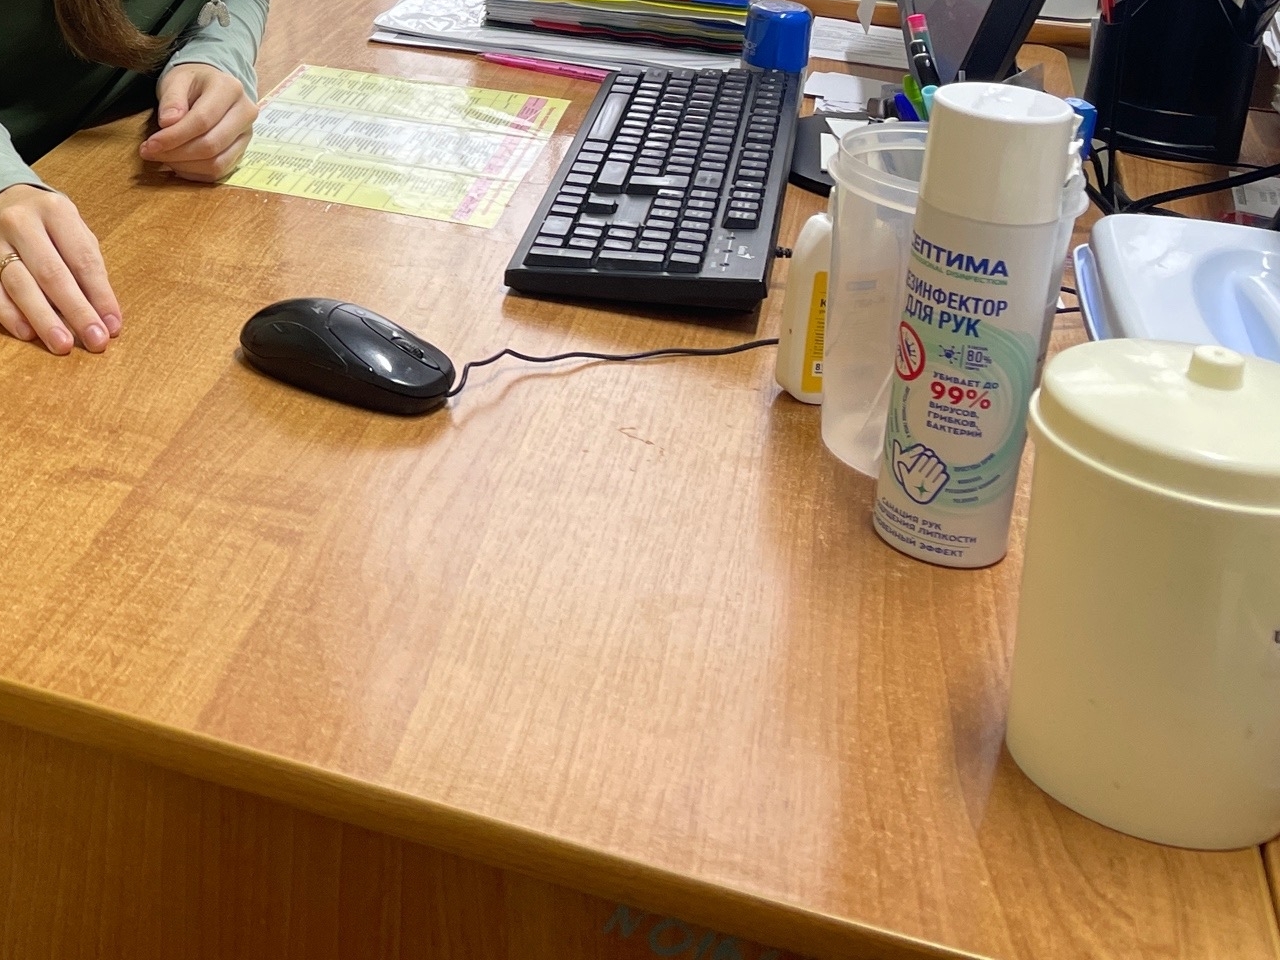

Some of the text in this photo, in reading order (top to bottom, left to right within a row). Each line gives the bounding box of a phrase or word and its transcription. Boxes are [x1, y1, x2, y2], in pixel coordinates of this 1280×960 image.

[912, 230, 1009, 277] ЕПТИМА
[906, 269, 1009, 318] ЕЗИНФЕКТОР
[904, 293, 982, 338] ДЛЯ РУК
[932, 371, 1000, 390] УБИВАЕТ ДО
[930, 381, 992, 410] 99%
[928, 400, 980, 419] ВИРУСОВ,
[927, 410, 981, 431] ГРИБКОВ,
[921, 519, 942, 531] РУК
[918, 527, 978, 544] ЛИПКОСТИ
[919, 542, 965, 558] ЭФФЕКТ
